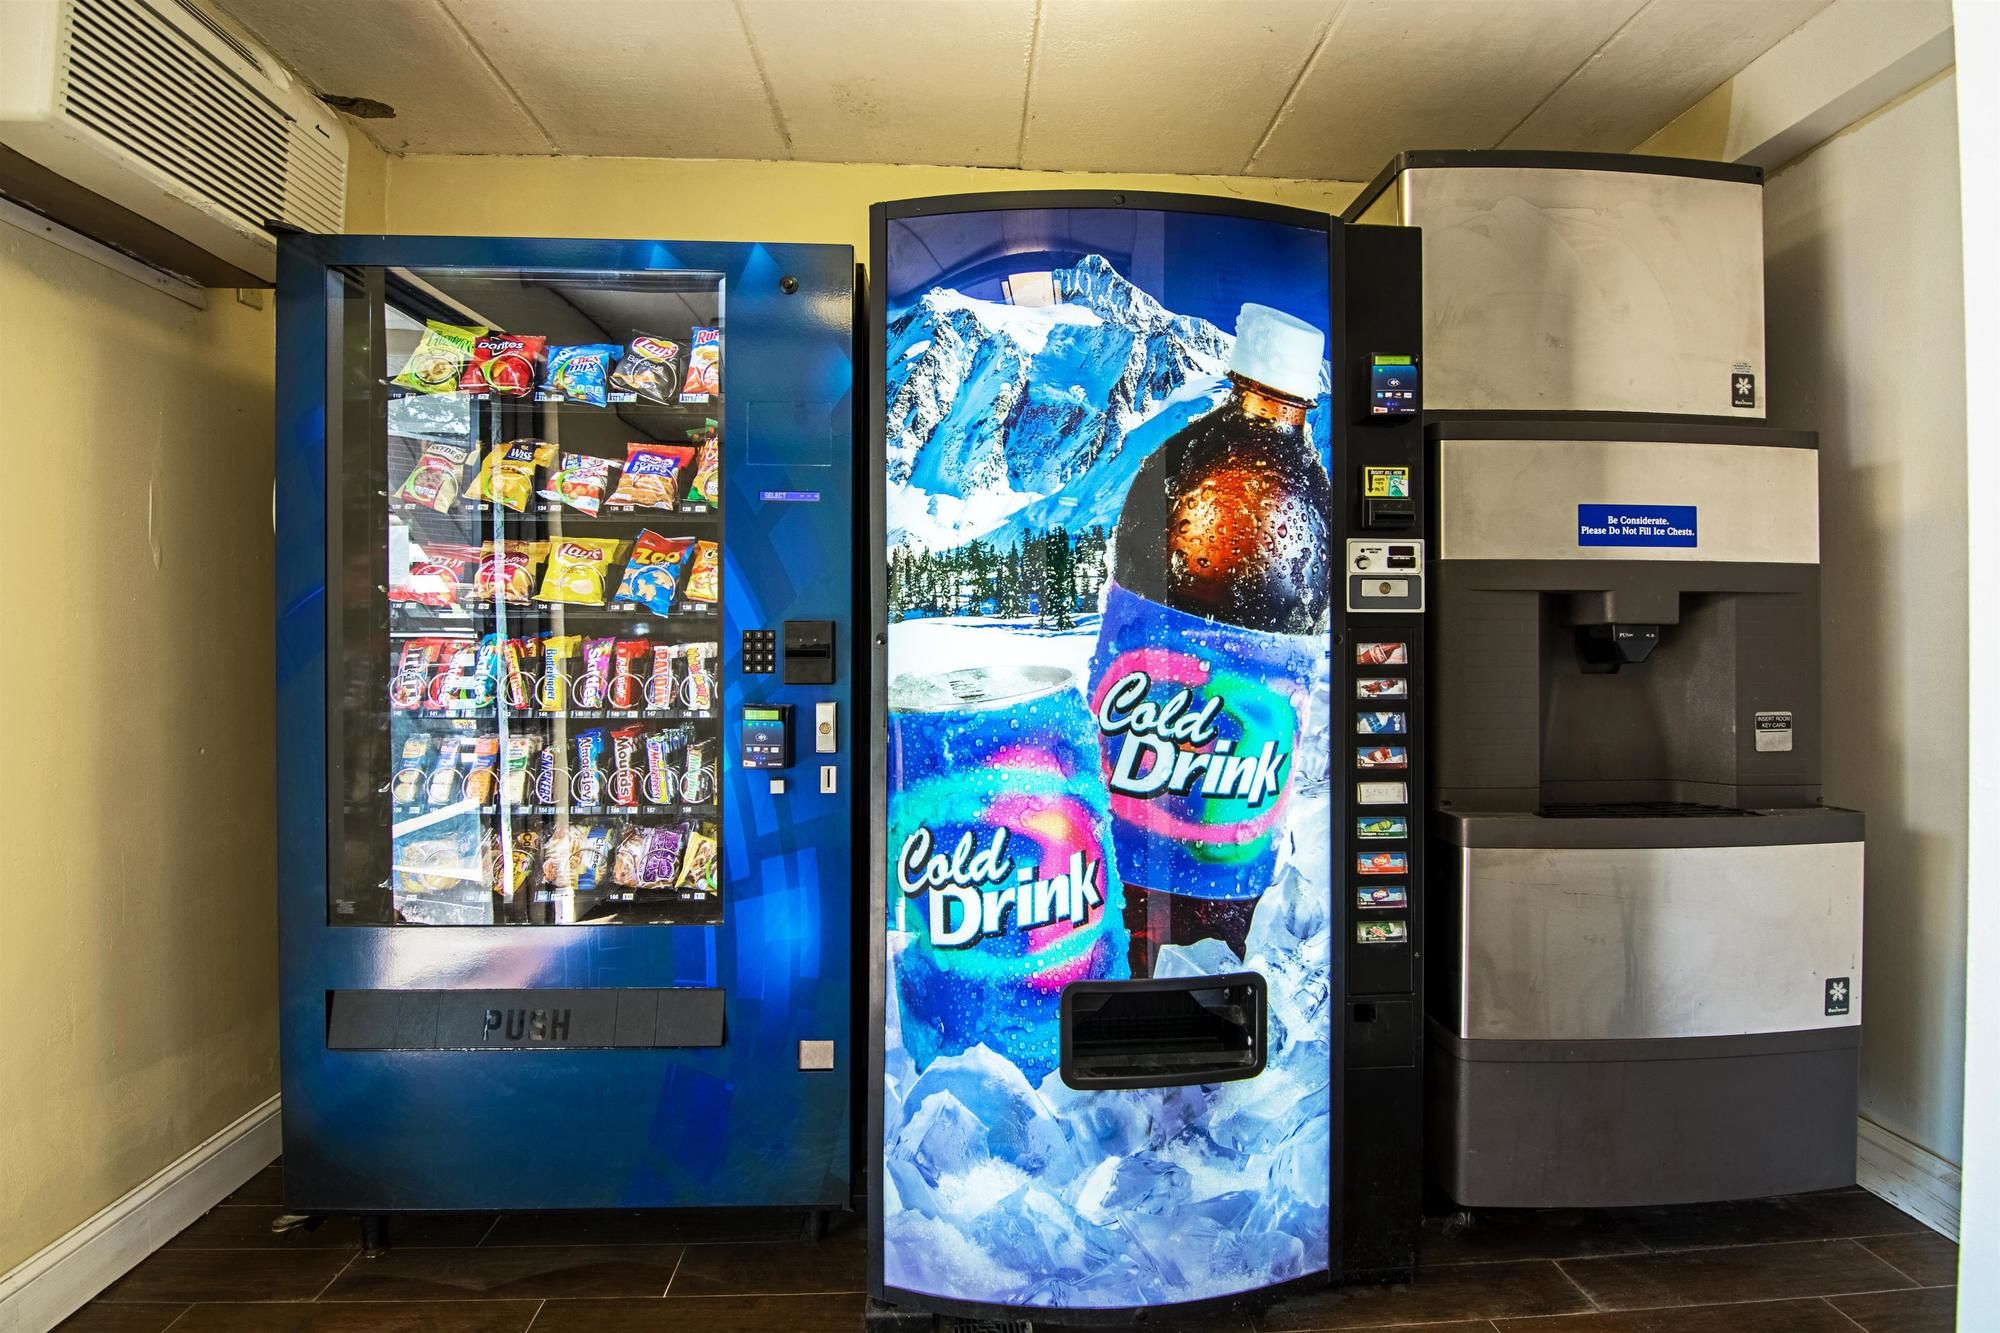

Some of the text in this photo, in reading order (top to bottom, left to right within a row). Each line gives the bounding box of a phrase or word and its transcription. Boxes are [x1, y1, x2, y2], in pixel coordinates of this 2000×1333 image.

[477, 340, 525, 350] Doritos
[1581, 526, 1695, 536] Please Do Not Fill Ice Chests.
[1608, 515, 1670, 525] Be Considerate.
[545, 648, 558, 701] Butterfinger
[582, 648, 602, 707] Skittles
[654, 650, 669, 705] PAYDAY
[1098, 671, 1224, 744] Cold
[616, 736, 632, 796] Mounds
[649, 751, 661, 798] Musketeers
[1110, 729, 1293, 808] Drink
[591, 837, 604, 869] Cheese
[897, 826, 1014, 896] Cold
[929, 850, 1105, 949] Drink
[482, 1008, 571, 1041] PUSH
